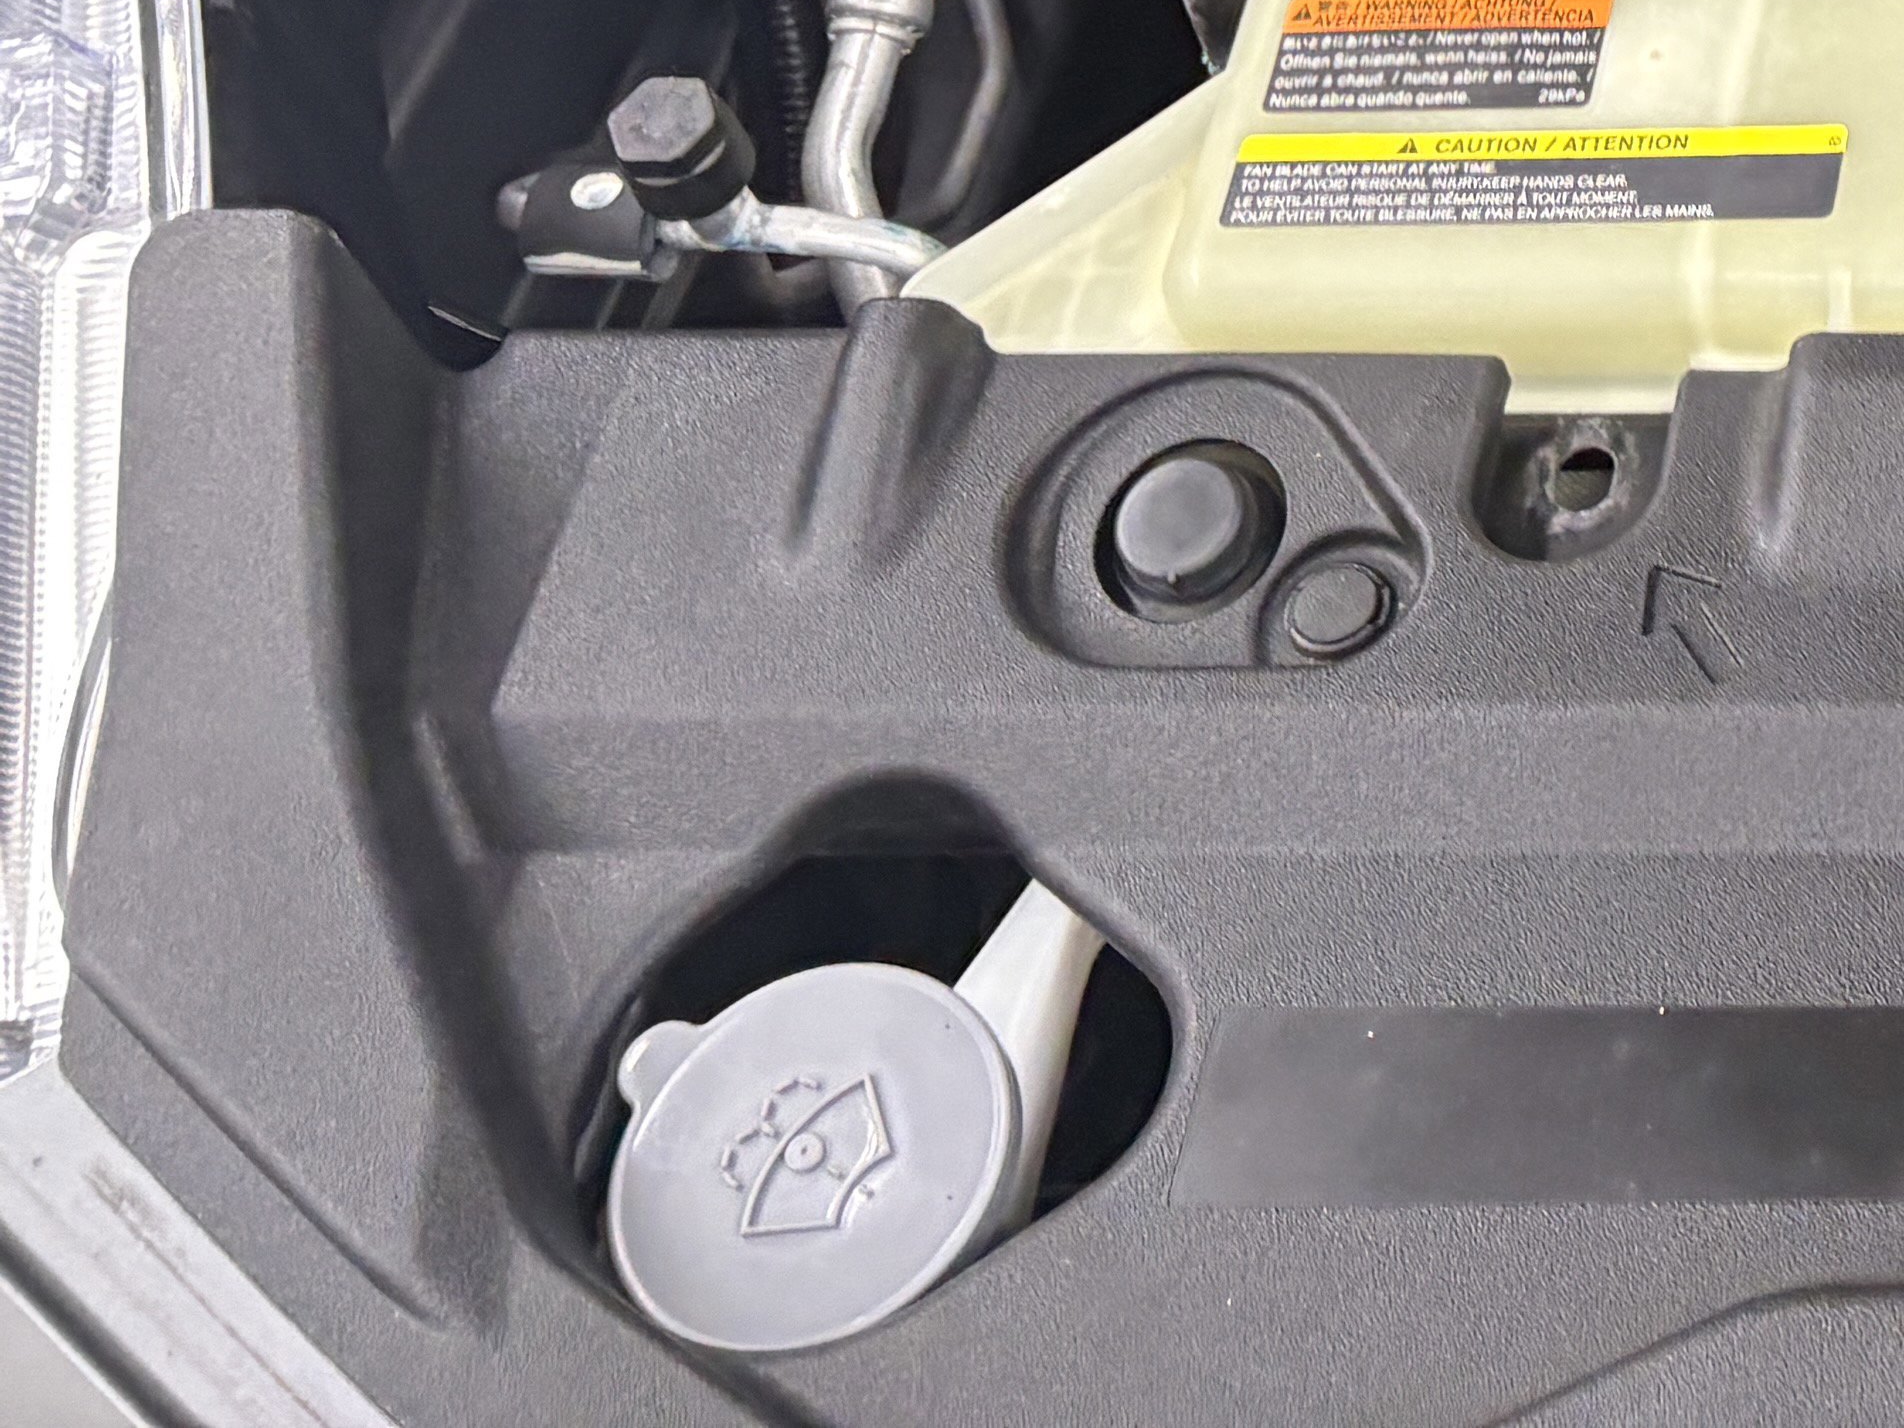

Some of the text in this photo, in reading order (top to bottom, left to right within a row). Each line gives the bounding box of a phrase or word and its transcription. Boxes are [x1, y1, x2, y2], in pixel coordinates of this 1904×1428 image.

[1435, 31, 1479, 45] Never
[1481, 31, 1518, 47] open
[1521, 30, 1560, 45] when
[1425, 51, 1464, 65] wenn
[1402, 70, 1449, 85] nunca
[1453, 68, 1490, 84] abrir
[1269, 93, 1318, 108] Nunca
[1320, 92, 1355, 108] abra
[1357, 91, 1413, 108] quando
[1435, 133, 1689, 154] CAUTION / ATTENTION
[1244, 163, 1272, 176] FAN
[1325, 162, 1358, 176] CAN
[1408, 162, 1425, 175] AT
[1428, 161, 1460, 174] ANY
[1241, 178, 1260, 193] TO
[1263, 177, 1301, 191] HELP
[1303, 177, 1348, 192] AVOID
[1352, 176, 1427, 191] PERSONAL
[1523, 175, 1574, 189] HANDS
[1410, 192, 1431, 206] DE
[1532, 191, 1570, 205] TOUT
[1517, 206, 1537, 220] EN
[1540, 205, 1633, 220] APPROCHER
